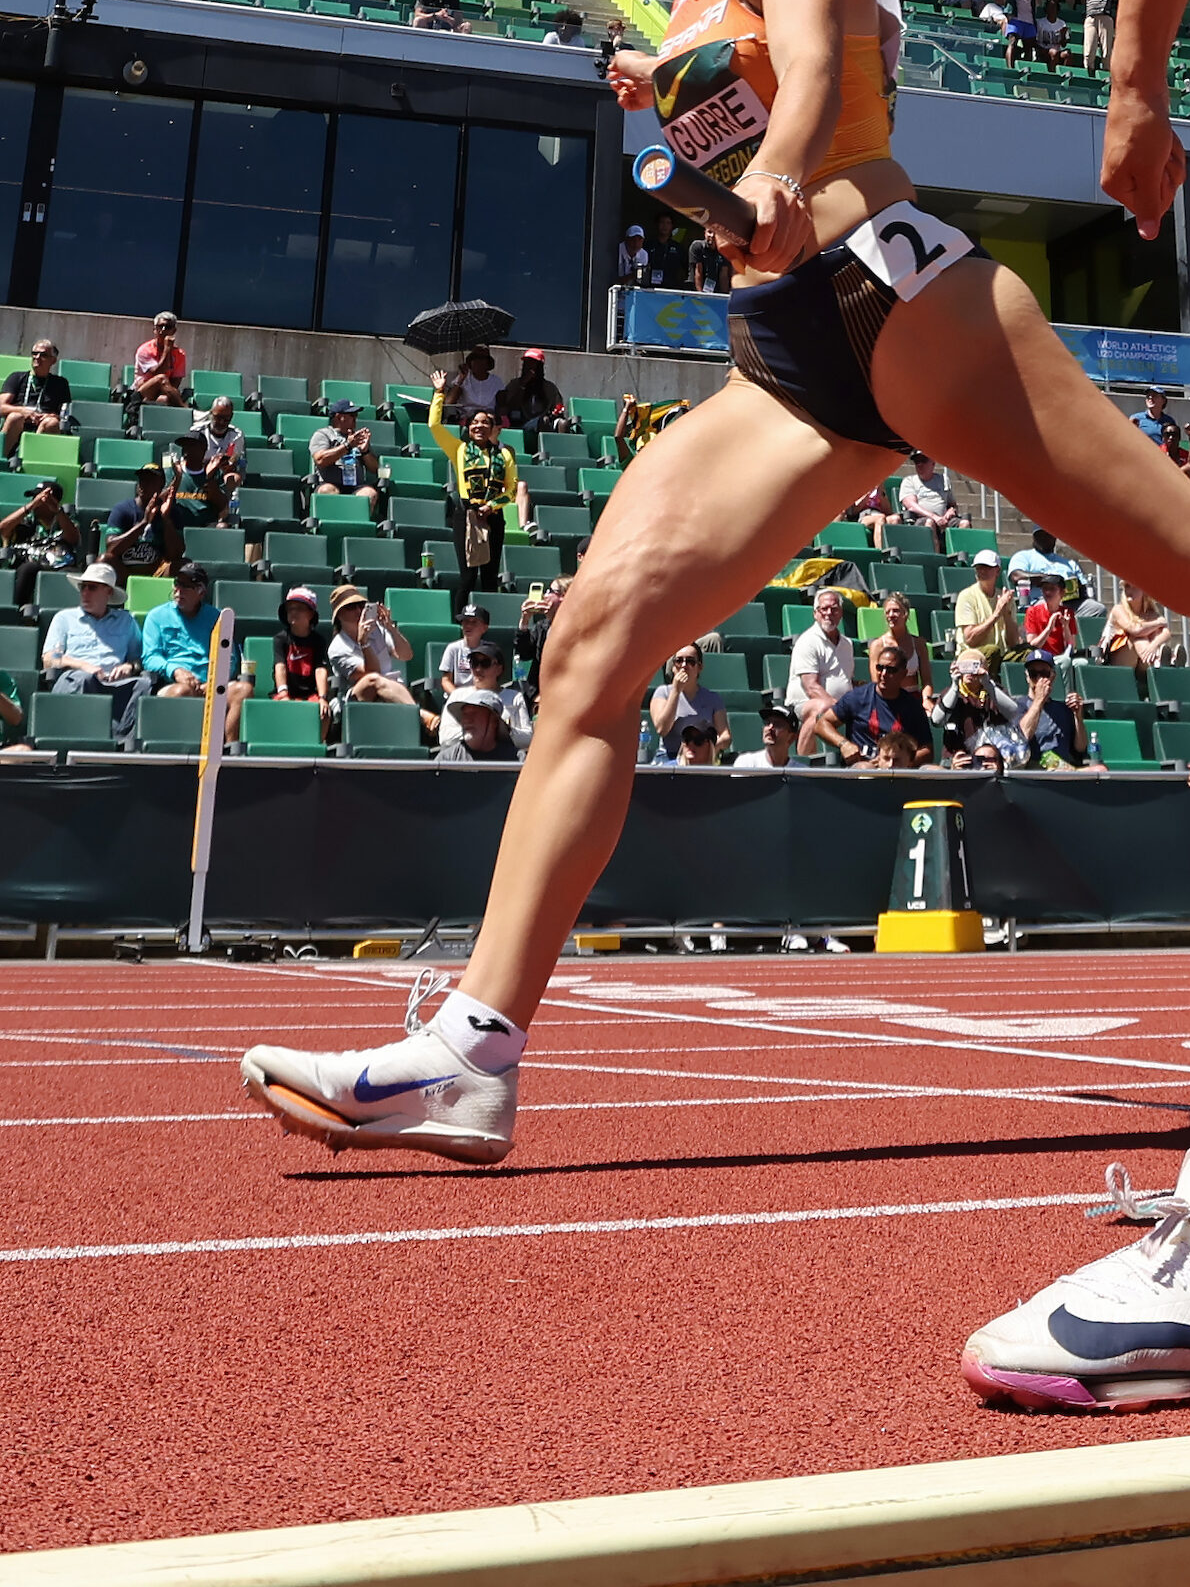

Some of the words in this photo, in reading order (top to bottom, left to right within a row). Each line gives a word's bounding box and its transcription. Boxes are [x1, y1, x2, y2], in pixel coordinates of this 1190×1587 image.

[879, 220, 947, 275] 2
[1096, 340, 1129, 351] WORLD
[1130, 343, 1177, 354] ATHLETICS
[1114, 351, 1177, 363] CHAMPIONSHIPS
[909, 838, 926, 898] 1
